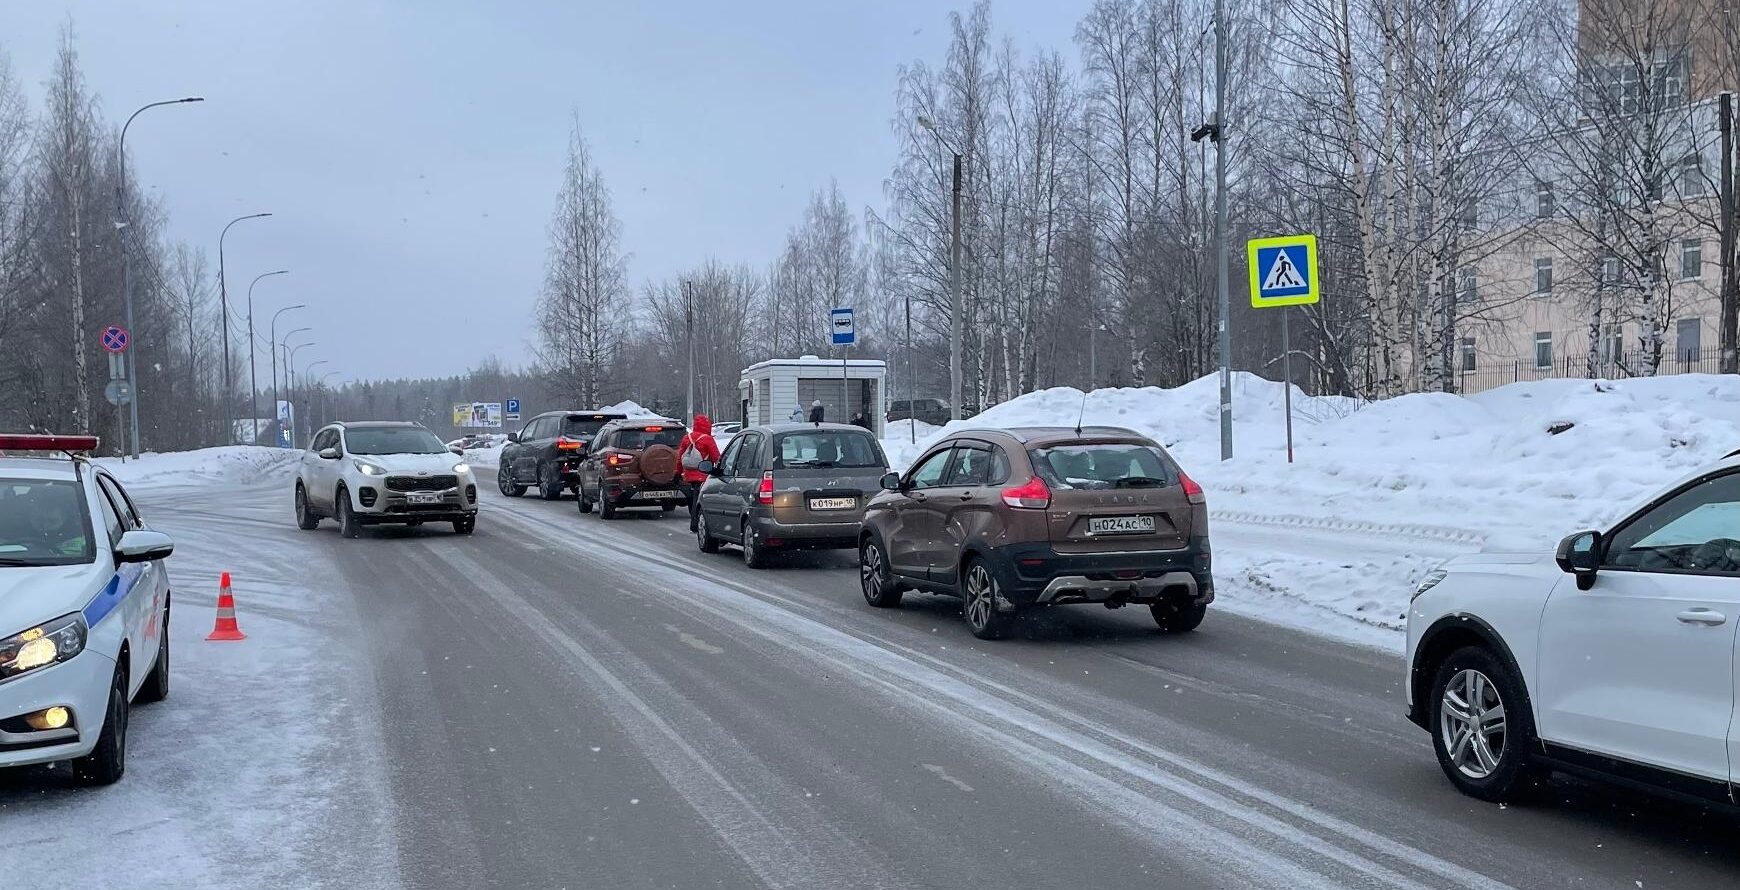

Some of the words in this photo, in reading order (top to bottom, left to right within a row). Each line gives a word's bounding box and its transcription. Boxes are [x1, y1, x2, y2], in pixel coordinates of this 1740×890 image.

[508, 401, 517, 411] P
[1099, 494, 1148, 503] LADA
[1094, 518, 1138, 531] Н024АС
[1141, 517, 1152, 527] 10
